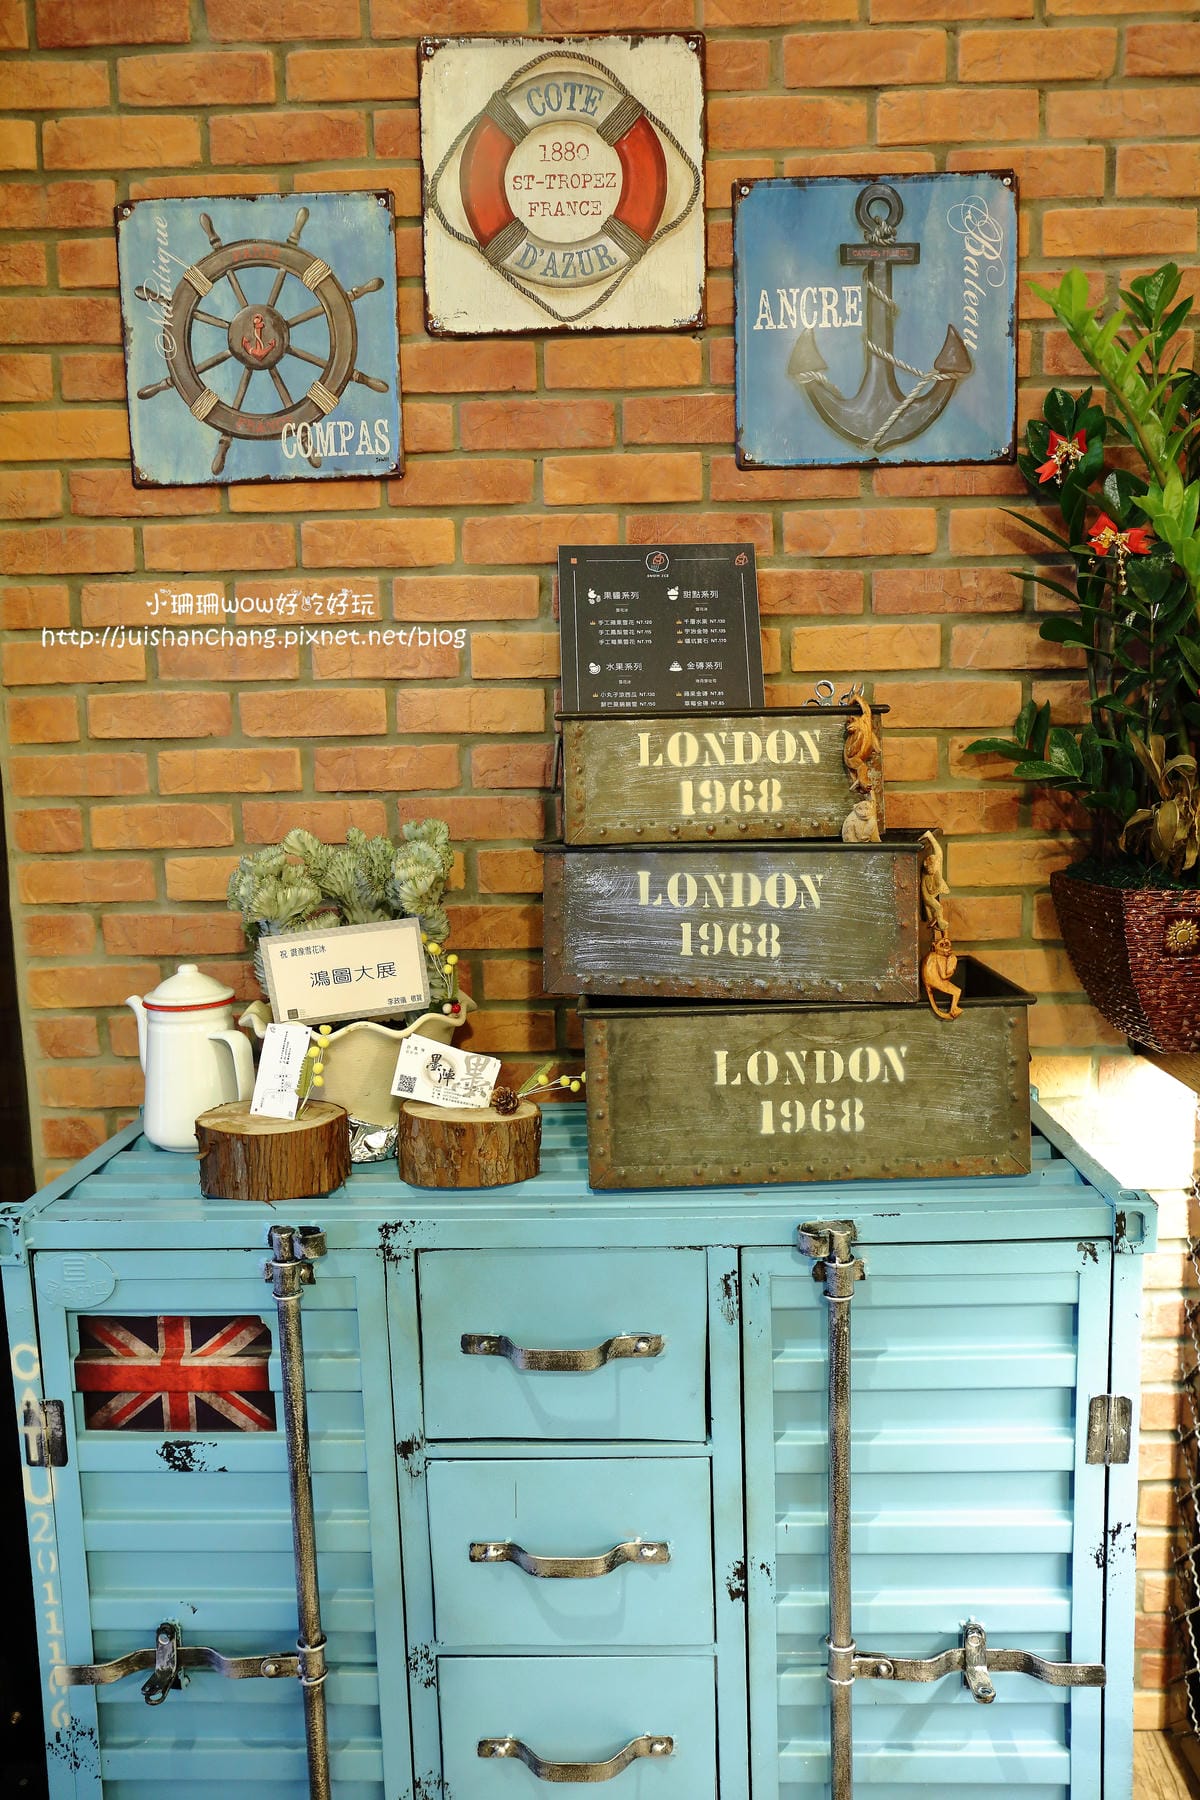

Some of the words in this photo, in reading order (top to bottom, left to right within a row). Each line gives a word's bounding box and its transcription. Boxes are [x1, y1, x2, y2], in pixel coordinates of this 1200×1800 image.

[526, 82, 605, 117] COTE
[539, 141, 590, 162] 1880
[512, 172, 617, 190] ST-TROPEZ
[528, 200, 602, 217] FRANCE
[515, 242, 617, 279] D'AZUR
[947, 195, 1006, 350] Bateau
[143, 216, 190, 361] Nautique
[753, 286, 862, 331] ANCRE
[281, 419, 391, 459] COMPAS
[606, 663, 643, 671] 水果系列
[638, 729, 822, 767] LONDON
[680, 777, 784, 816] 1968
[637, 870, 824, 909] LONDON
[279, 950, 288, 959] 祝
[680, 922, 781, 957] 1968
[310, 961, 398, 988] 鴻圖大展
[714, 1047, 908, 1085] LONDON
[760, 1098, 866, 1135] 1968
